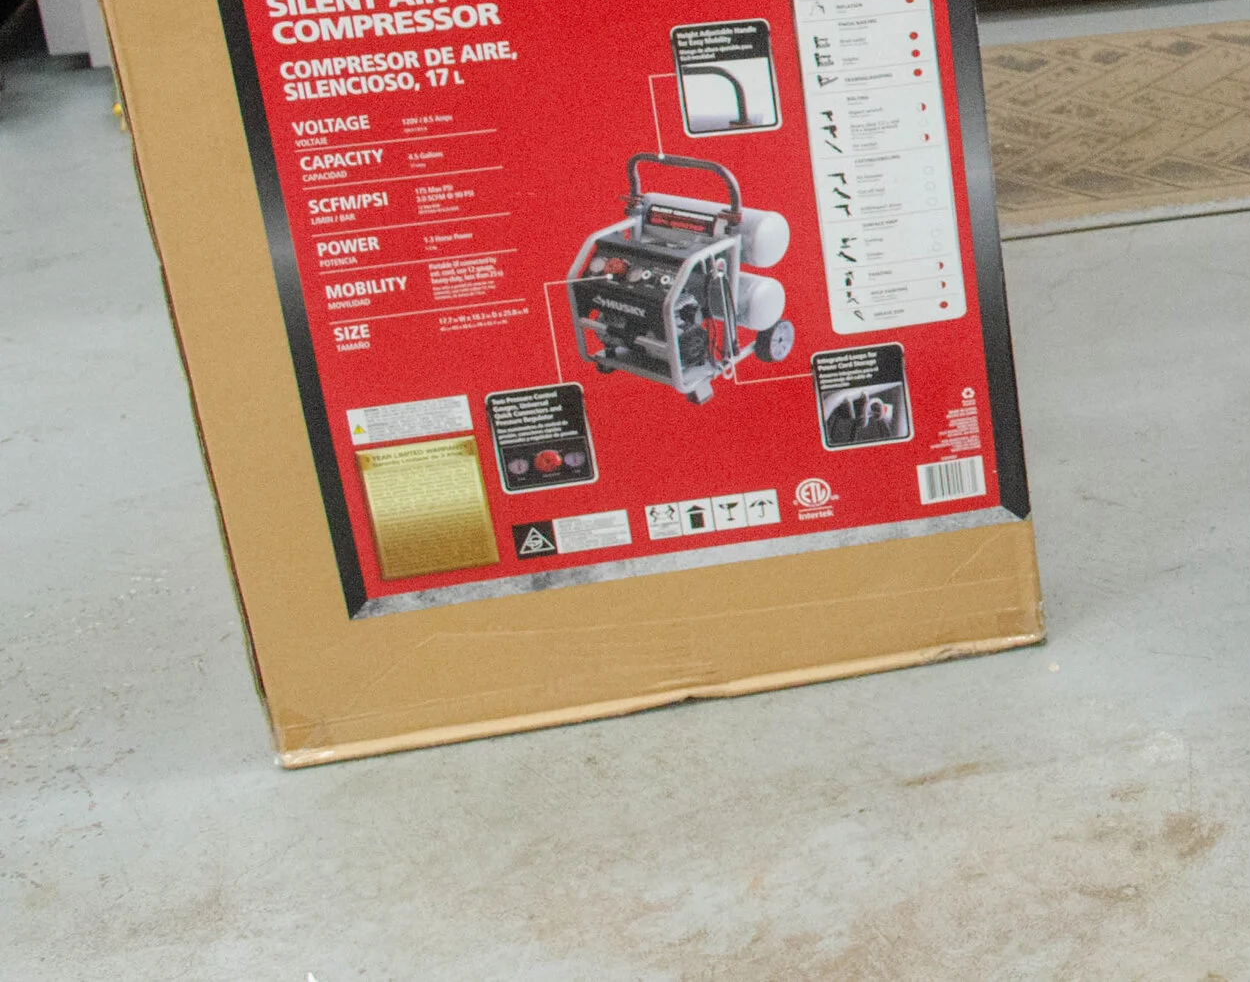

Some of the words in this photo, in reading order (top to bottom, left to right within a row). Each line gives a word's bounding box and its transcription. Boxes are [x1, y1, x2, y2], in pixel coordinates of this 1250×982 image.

[272, 3, 502, 45] COMPRESSOR
[279, 49, 422, 80] COMPRESOR
[425, 47, 456, 66] DE
[460, 41, 519, 62] AIRE,
[283, 72, 421, 102] SILENCIOSO,
[425, 69, 450, 89] 17
[453, 70, 465, 85] L
[291, 114, 371, 136] VOLTAGE
[300, 148, 384, 172] CAPACITY
[308, 191, 389, 215] SCFM/PSI
[316, 236, 380, 257] POWER
[325, 276, 408, 300] MOBILITY
[333, 323, 371, 342] SIZE
